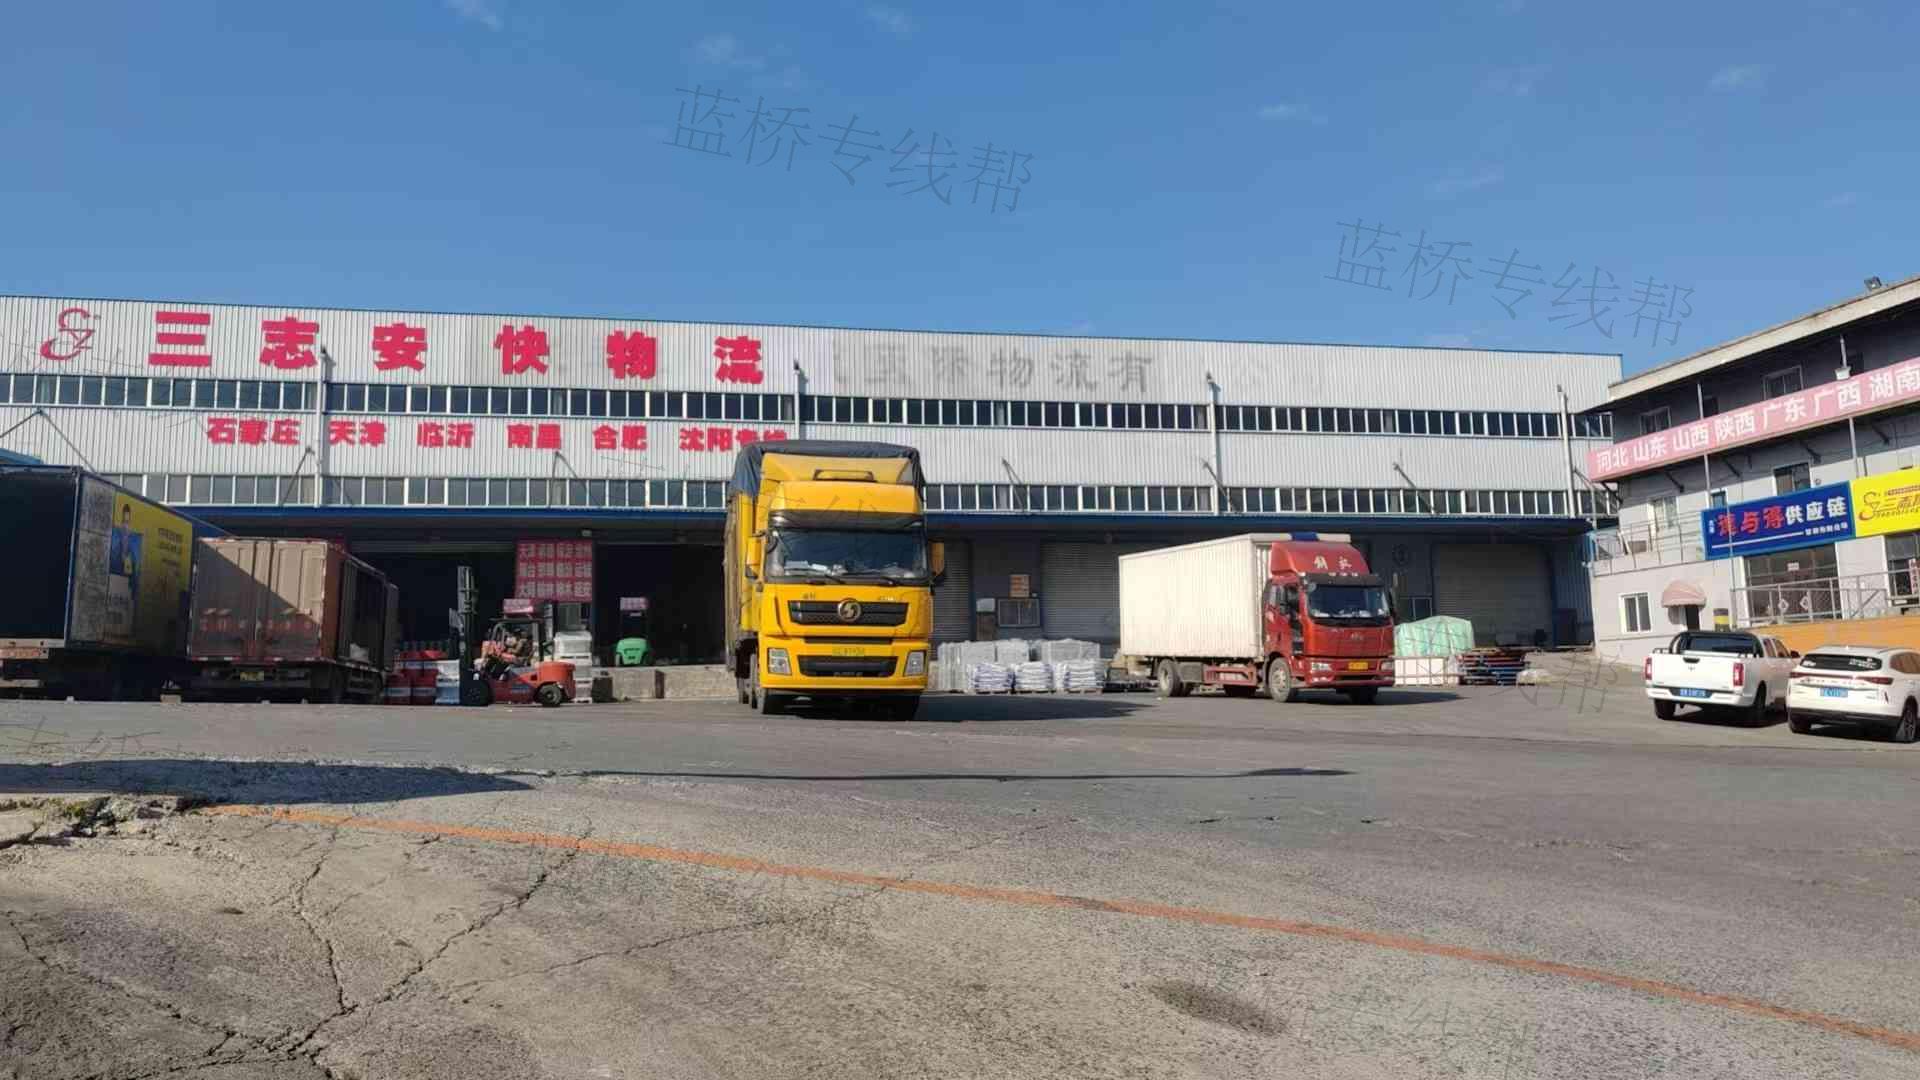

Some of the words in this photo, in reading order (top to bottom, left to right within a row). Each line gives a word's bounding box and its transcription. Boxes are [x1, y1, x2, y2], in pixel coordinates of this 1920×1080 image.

[148, 311, 764, 385] 三志安快物流
[207, 417, 301, 446] 石家庄
[329, 420, 386, 447] 天津
[417, 422, 474, 448] 临沂
[507, 424, 562, 449] 南昌
[593, 425, 648, 450] 合肥
[1597, 450, 1628, 474] 河北
[1633, 439, 1668, 463] 山东
[1673, 425, 1710, 451] 山西
[1714, 410, 1756, 443] 陕西
[1762, 397, 1807, 430] 广东
[1813, 380, 1861, 418] 广西
[1869, 365, 1920, 401] 湖南
